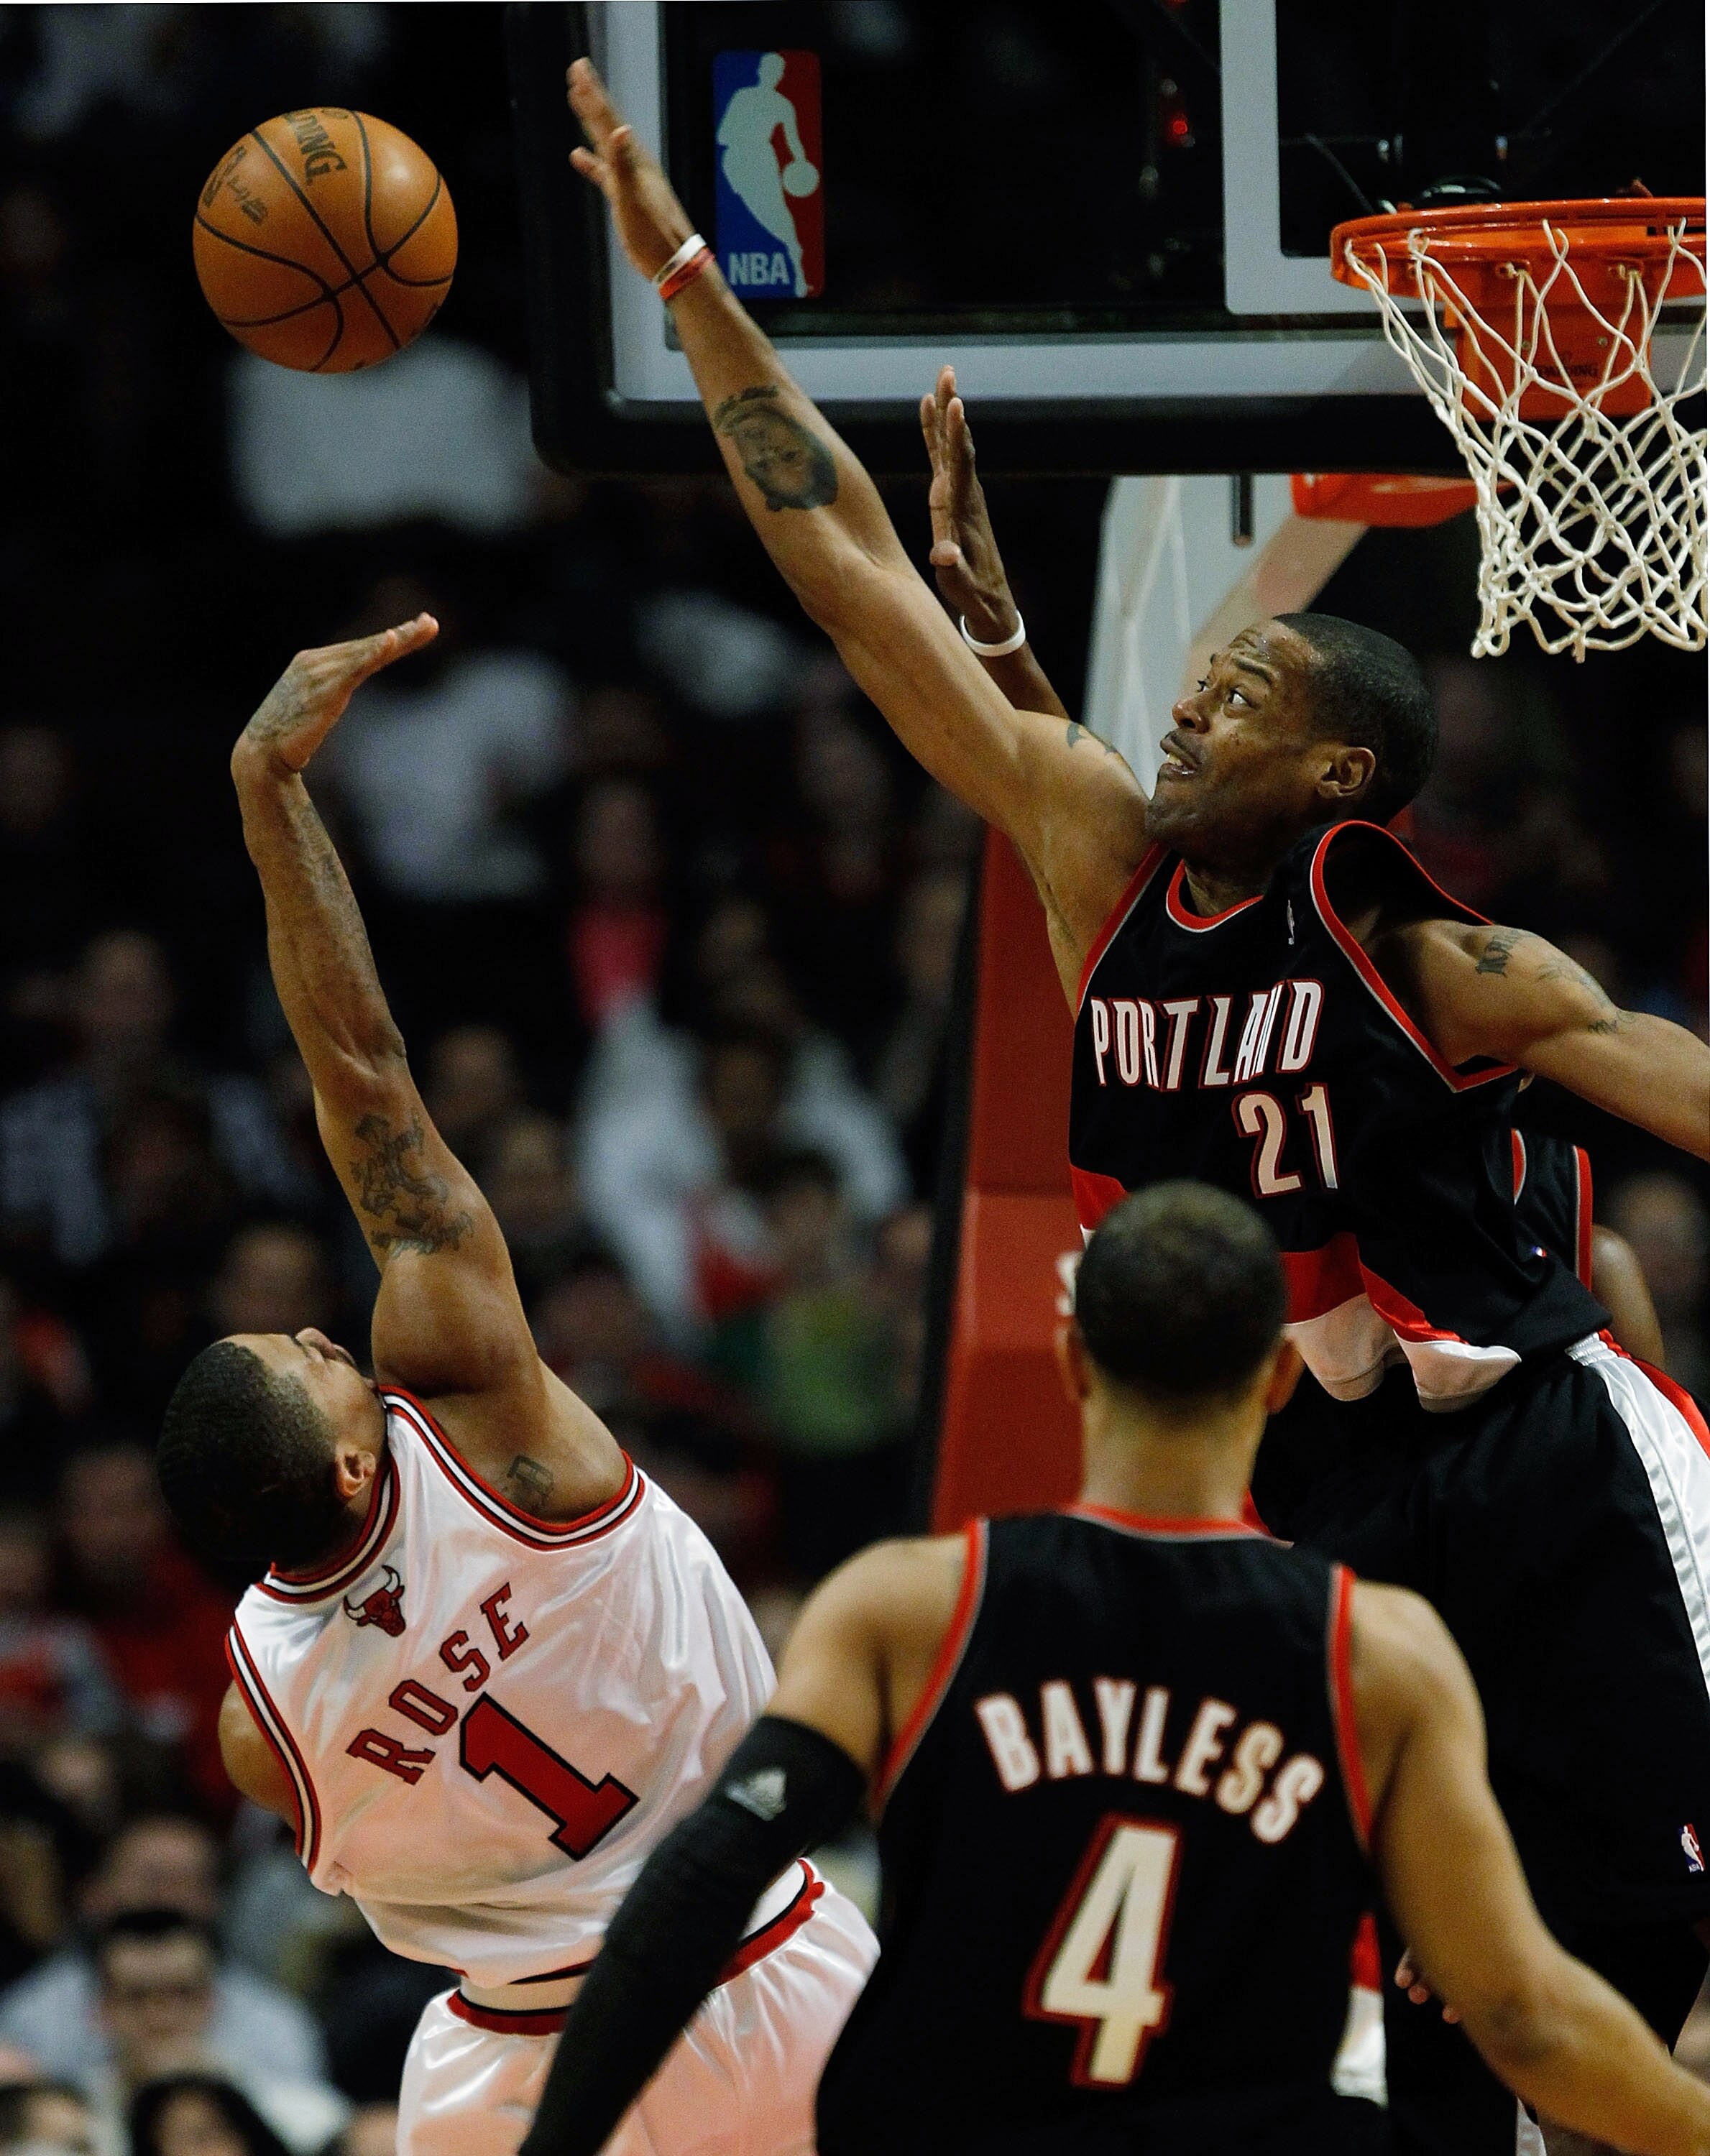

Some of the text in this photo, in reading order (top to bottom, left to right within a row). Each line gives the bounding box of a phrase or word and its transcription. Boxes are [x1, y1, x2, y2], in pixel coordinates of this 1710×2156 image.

[728, 252, 791, 286] NBA
[1231, 1082, 1339, 1199] 21
[345, 1581, 530, 1786] ROSE
[974, 1675, 1326, 1845] BAYLESS
[459, 1691, 640, 1862] 1
[1021, 1811, 1184, 2092] 4
